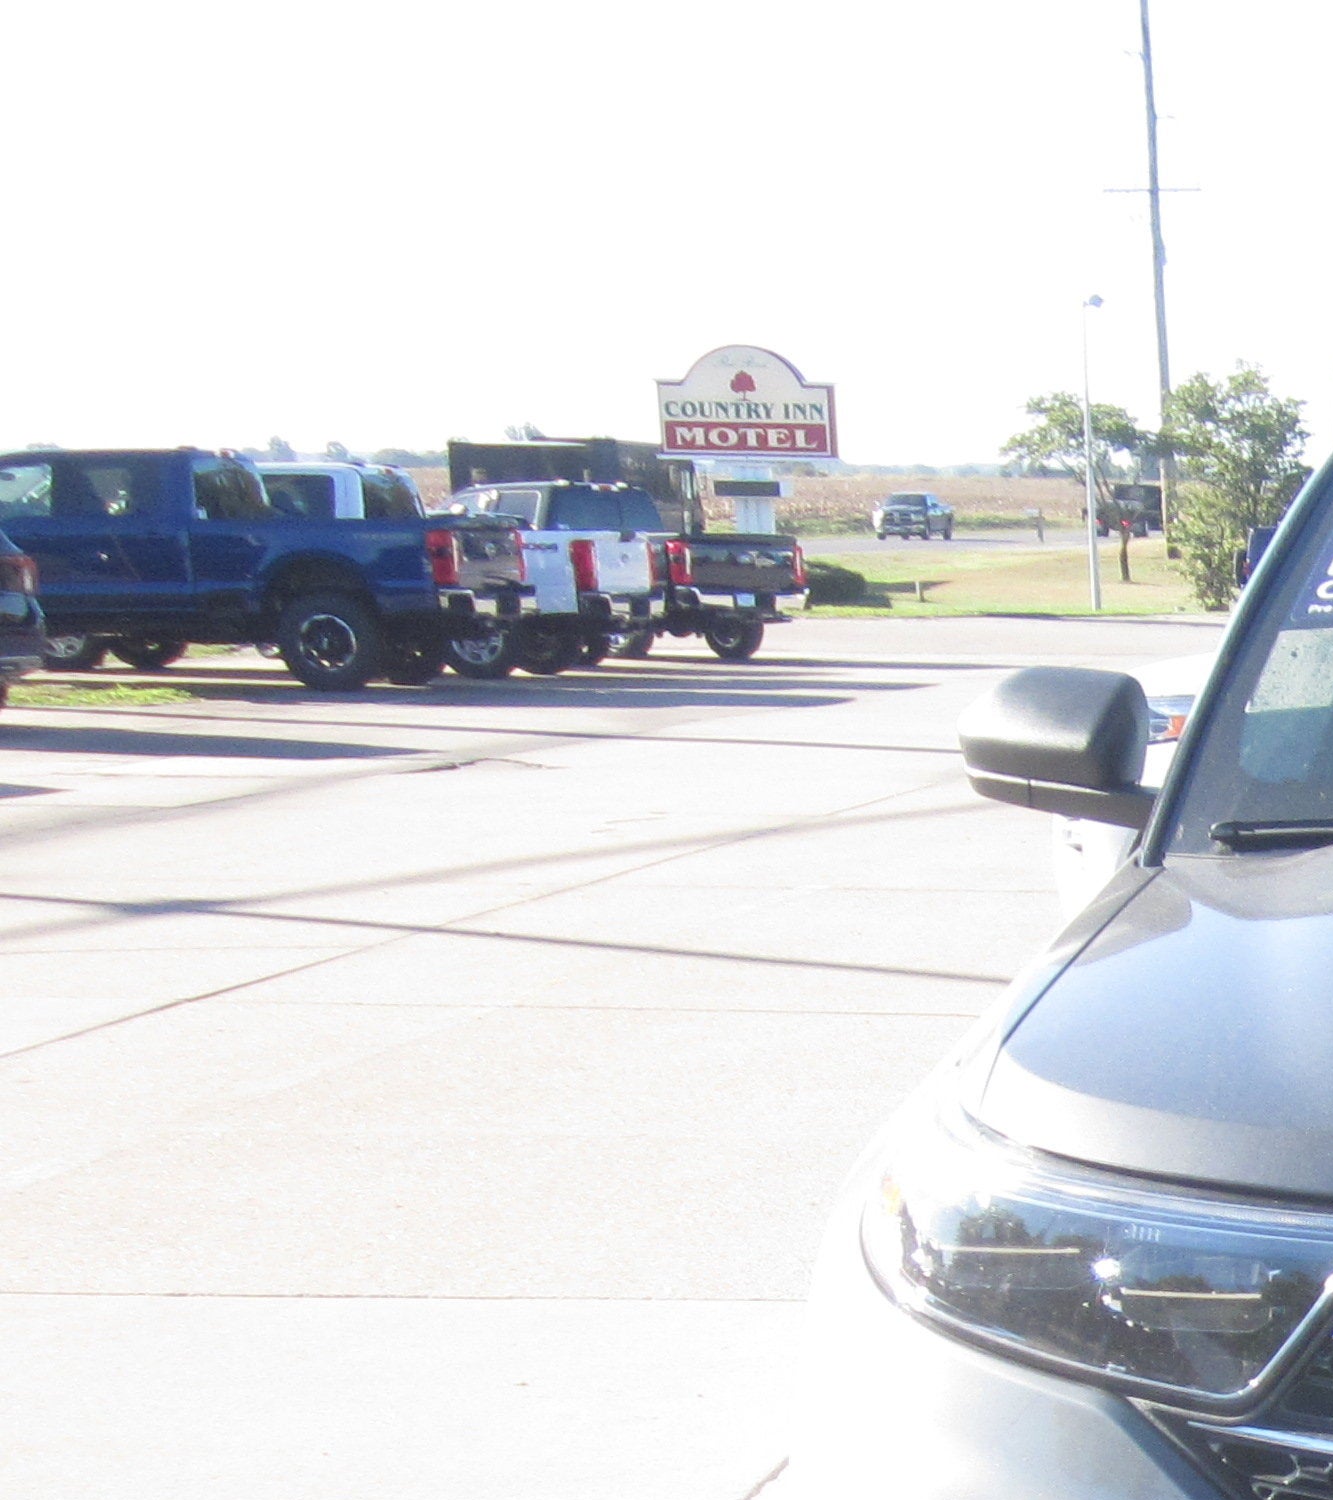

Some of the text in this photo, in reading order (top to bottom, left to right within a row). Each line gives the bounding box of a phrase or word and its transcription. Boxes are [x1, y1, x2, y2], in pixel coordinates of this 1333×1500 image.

[664, 400, 825, 421] COUNTRY INN
[674, 426, 818, 448] MOTEL
